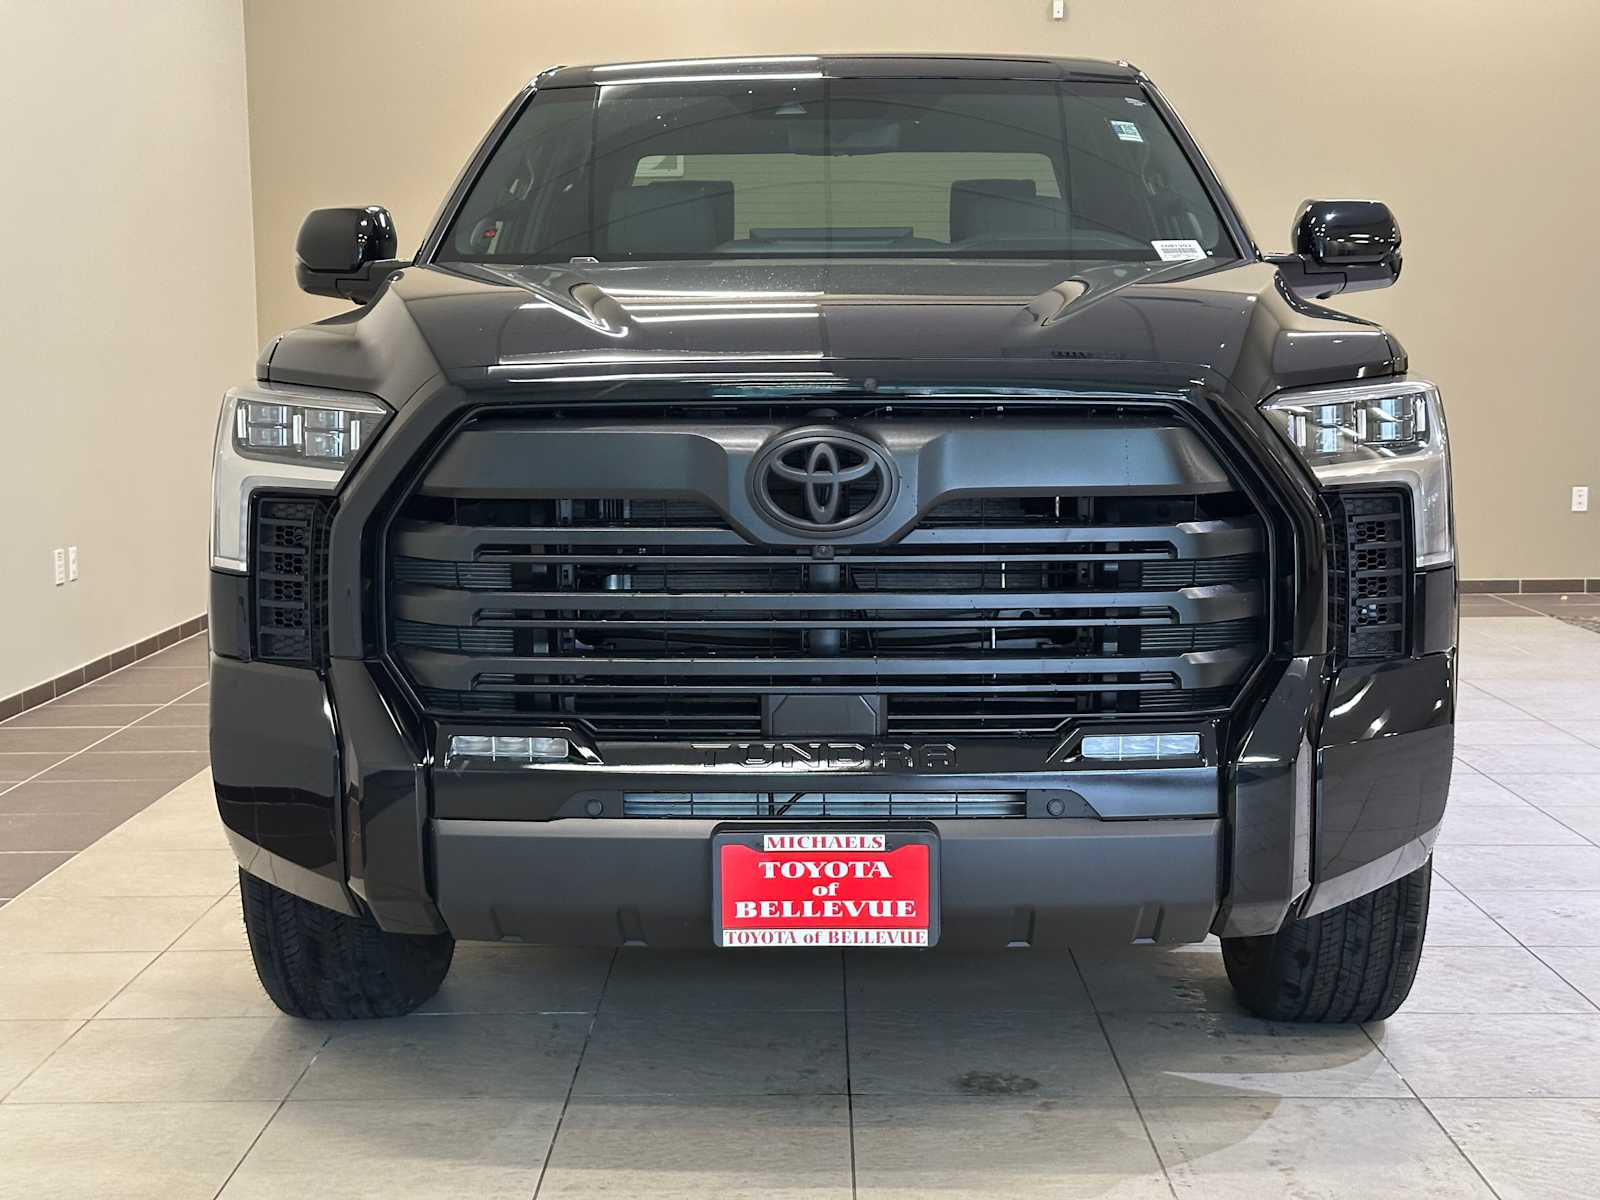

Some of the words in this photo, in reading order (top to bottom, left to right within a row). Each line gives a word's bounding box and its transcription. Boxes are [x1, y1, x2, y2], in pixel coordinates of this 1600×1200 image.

[691, 743, 957, 768] TUNDRA
[767, 836, 883, 849] MICHAELS
[758, 861, 892, 879] TOYOTA
[812, 882, 840, 897] of
[734, 900, 916, 918] BELLEVUE
[725, 931, 796, 945] TOYOTA
[803, 931, 823, 945] of
[828, 931, 926, 945] BELLEVUE
